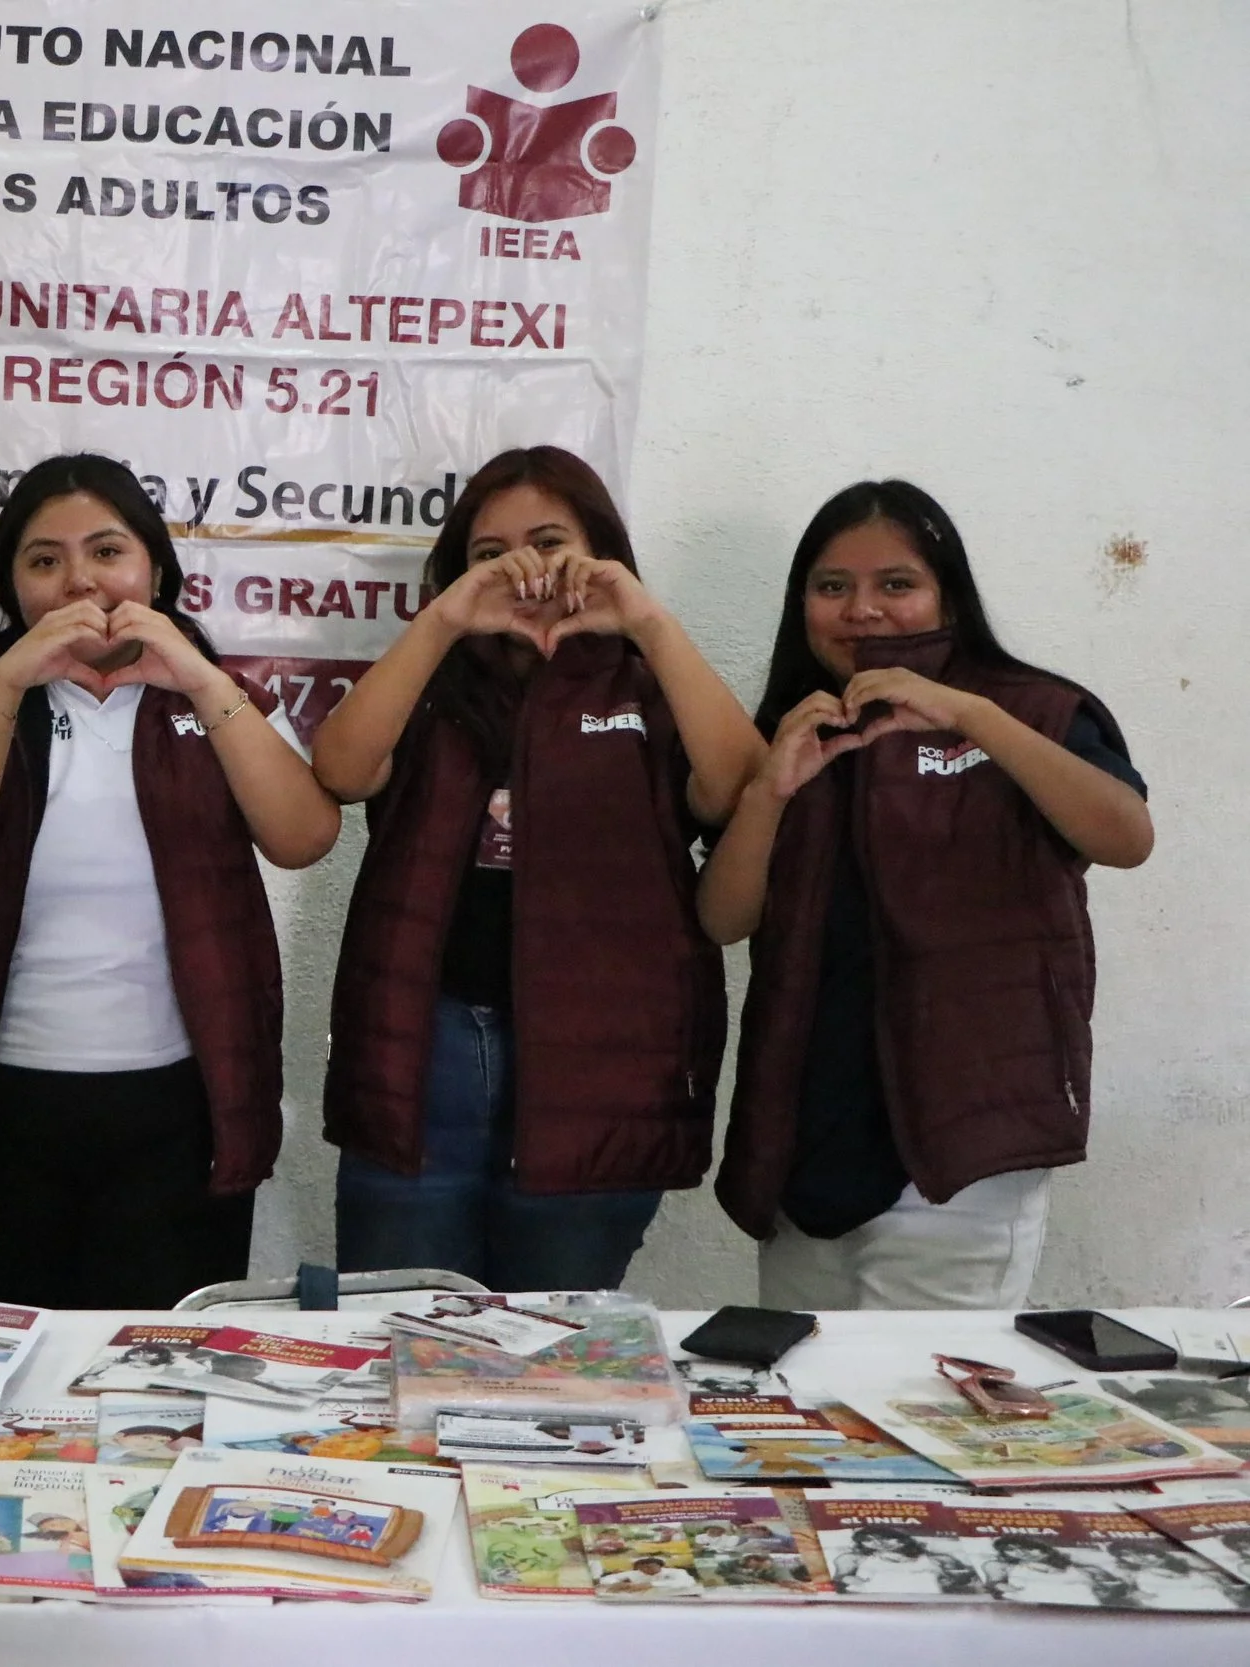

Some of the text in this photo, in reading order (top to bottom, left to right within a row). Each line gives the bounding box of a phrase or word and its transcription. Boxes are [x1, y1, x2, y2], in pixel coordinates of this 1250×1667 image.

[104, 29, 411, 77] NACIONAL
[43, 100, 392, 152] EDUCACIÓN
[56, 177, 330, 225] ADULTOS
[480, 227, 581, 261] IEEA
[272, 293, 567, 349] ALTEPEXI
[3, 352, 245, 411] REGIÓN
[264, 368, 380, 417] 5.21
[185, 476, 220, 532] y
[234, 465, 457, 528] Secund
[234, 575, 434, 622] GRATU
[918, 746, 945, 759] POR
[152, 1337, 192, 1345] INEA
[824, 1502, 928, 1510] Servicios
[866, 1516, 922, 1525] INEA
